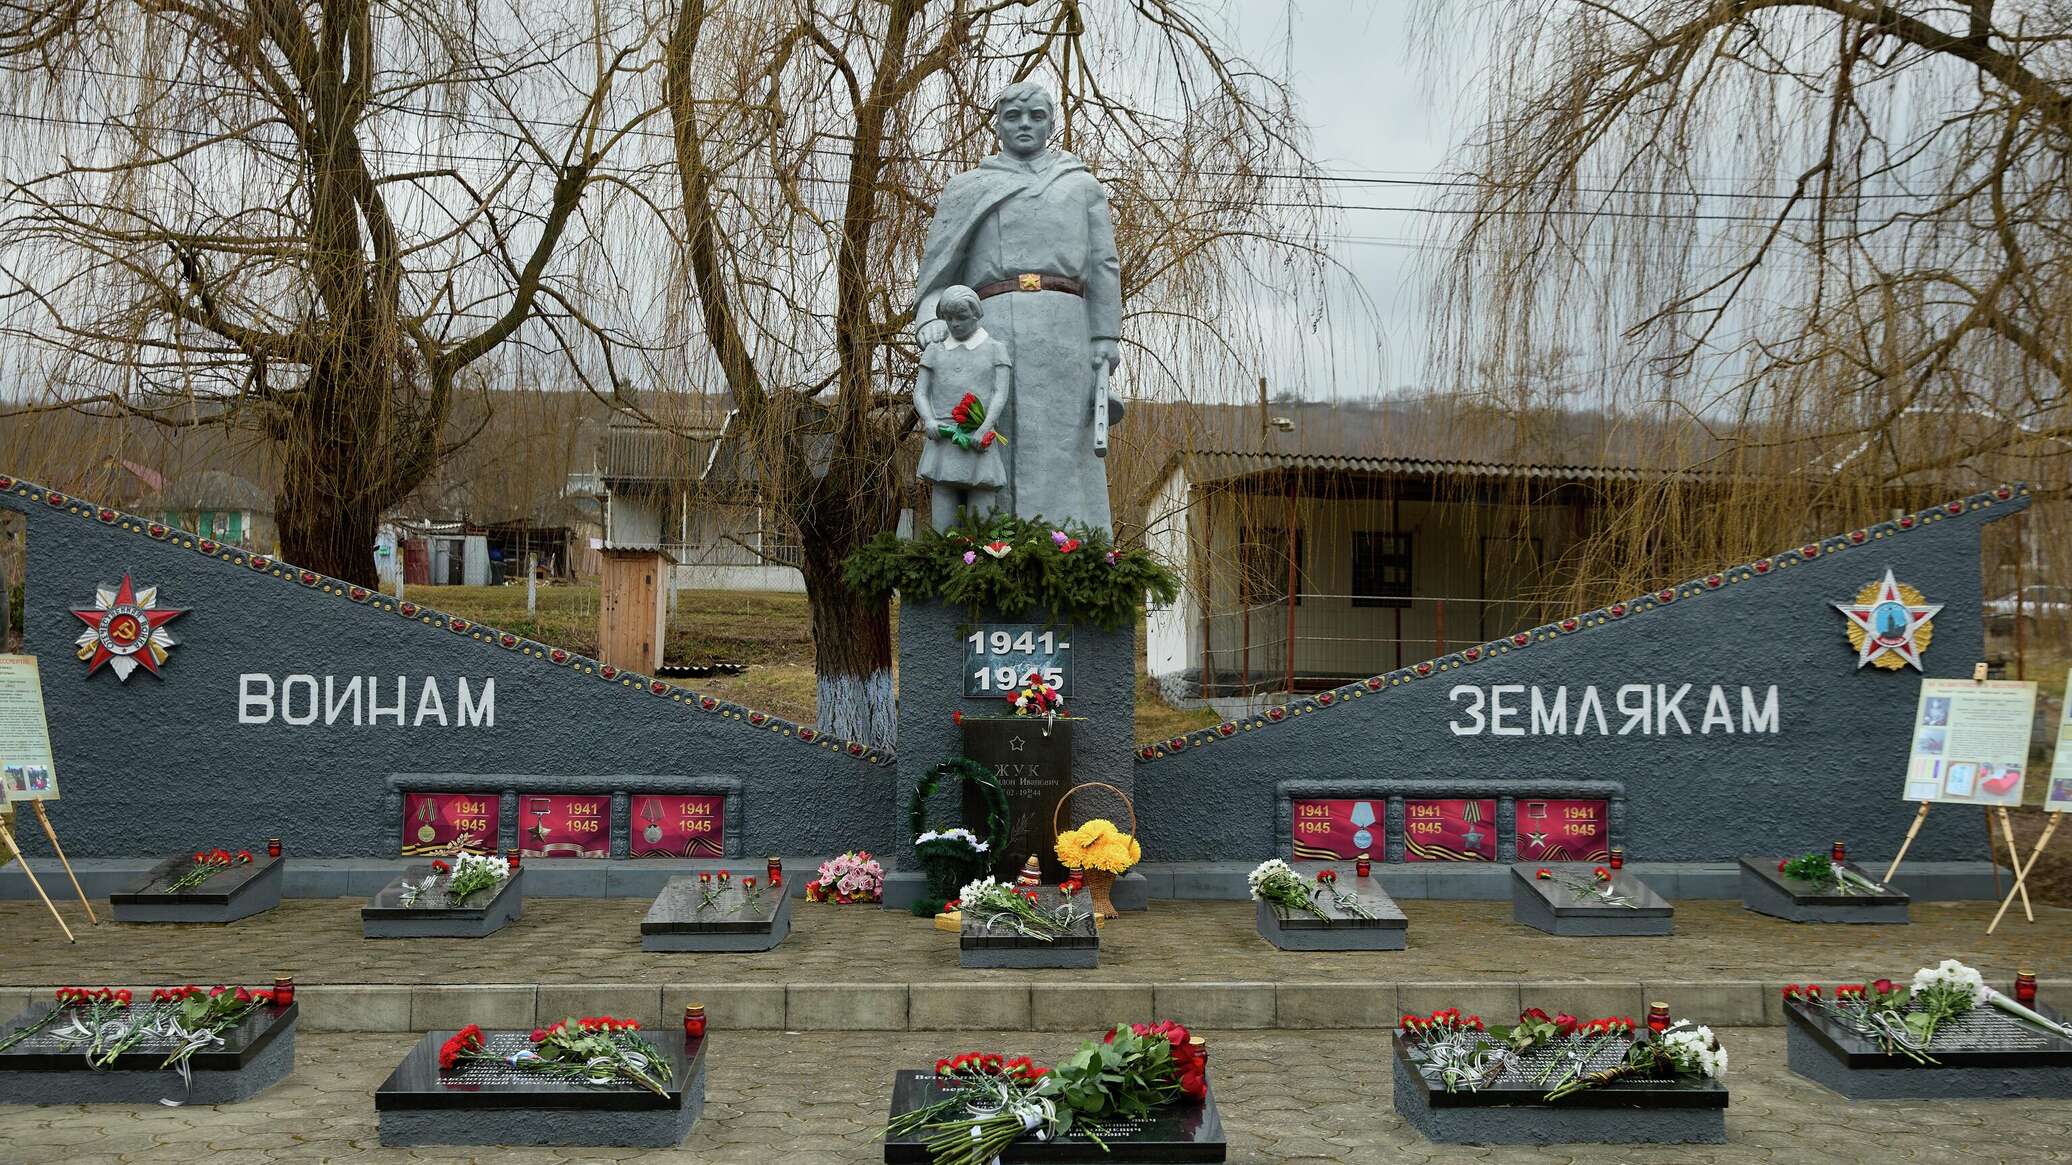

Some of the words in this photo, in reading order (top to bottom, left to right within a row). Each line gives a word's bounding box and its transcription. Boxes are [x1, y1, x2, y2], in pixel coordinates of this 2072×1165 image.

[969, 631, 1070, 655] 1941-
[974, 667, 1064, 691] 1945
[238, 673, 495, 727] ВОИНАМ
[1449, 683, 1780, 736] ЗЕМЛЯКАМ
[453, 802, 487, 815] 1941
[566, 802, 598, 815] 1941
[679, 802, 711, 815] 1941
[1298, 804, 1330, 817] 1941
[1409, 804, 1441, 817] 1941
[1563, 806, 1595, 819] 1941
[453, 818, 487, 832] 1945
[565, 819, 599, 833] 1945
[679, 819, 711, 833] 1945
[1298, 822, 1331, 834] 1945
[1409, 822, 1442, 834] 1945
[1563, 823, 1596, 836] 1945
